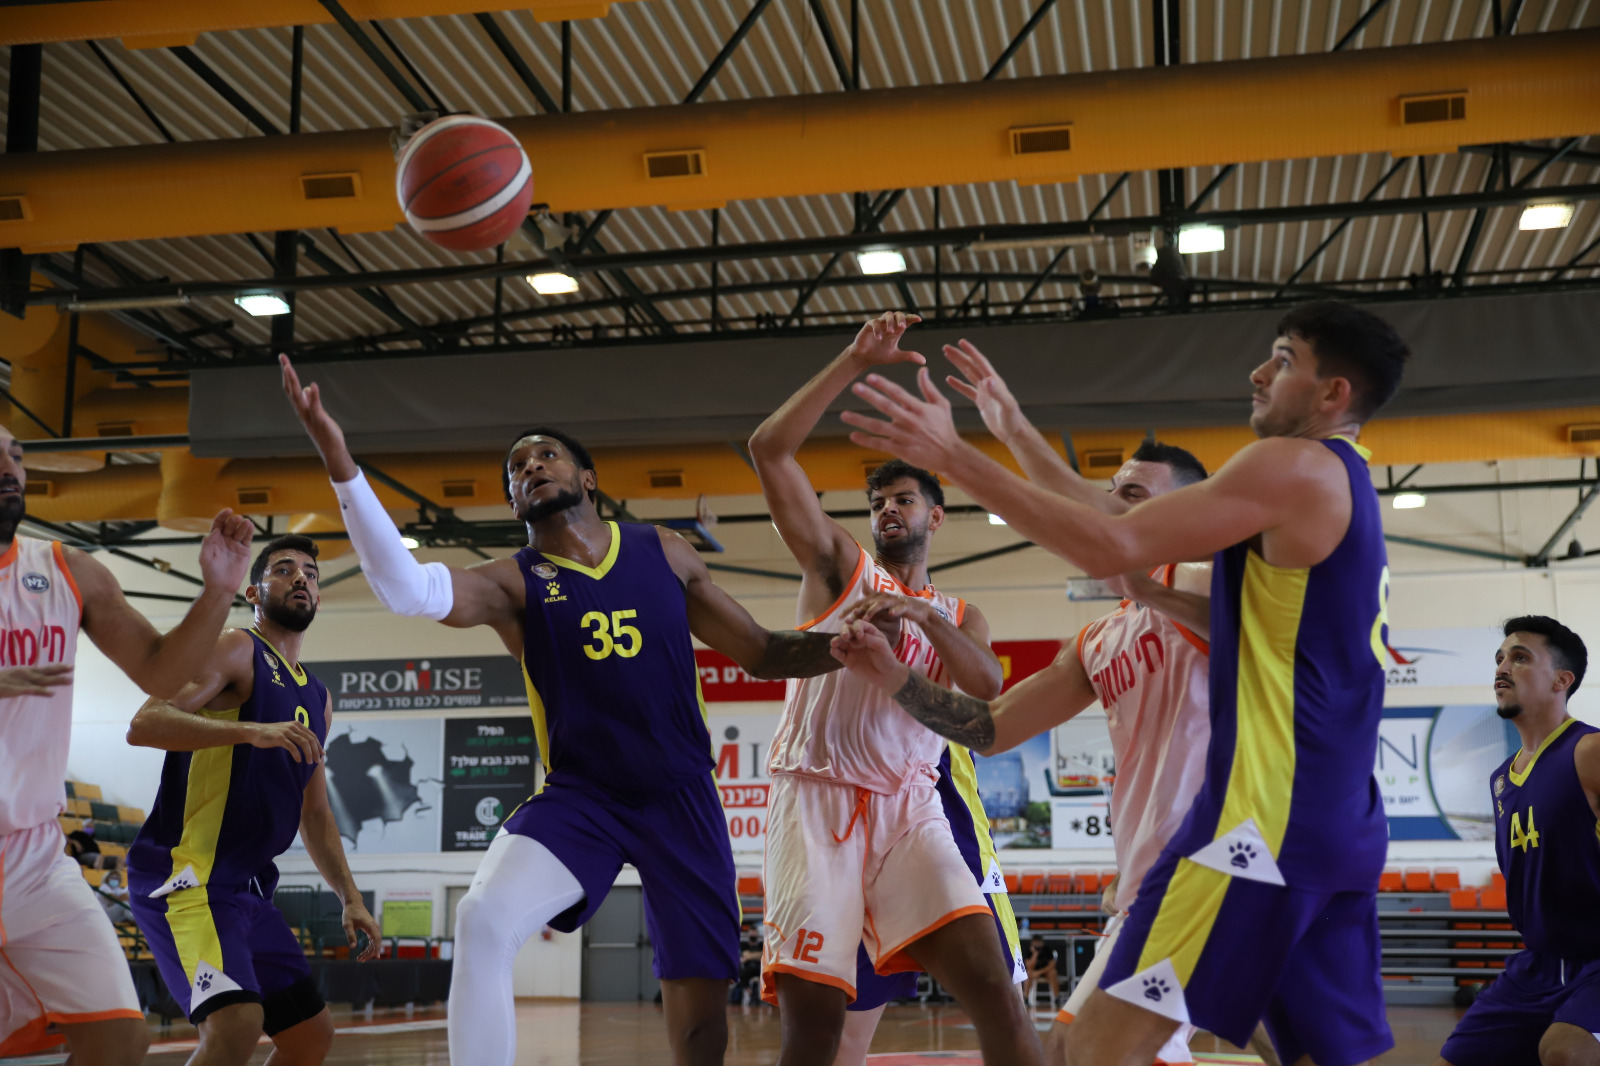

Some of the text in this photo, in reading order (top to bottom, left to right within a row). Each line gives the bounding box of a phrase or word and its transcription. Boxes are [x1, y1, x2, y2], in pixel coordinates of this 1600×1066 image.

[544, 595, 567, 603] KELME
[42, 625, 66, 663] חי
[580, 609, 642, 660] 35
[340, 660, 483, 693] PROMISE
[386, 696, 411, 708] סדר
[414, 693, 441, 708] לכם
[1510, 805, 1540, 853] 44
[792, 928, 824, 964] 12
